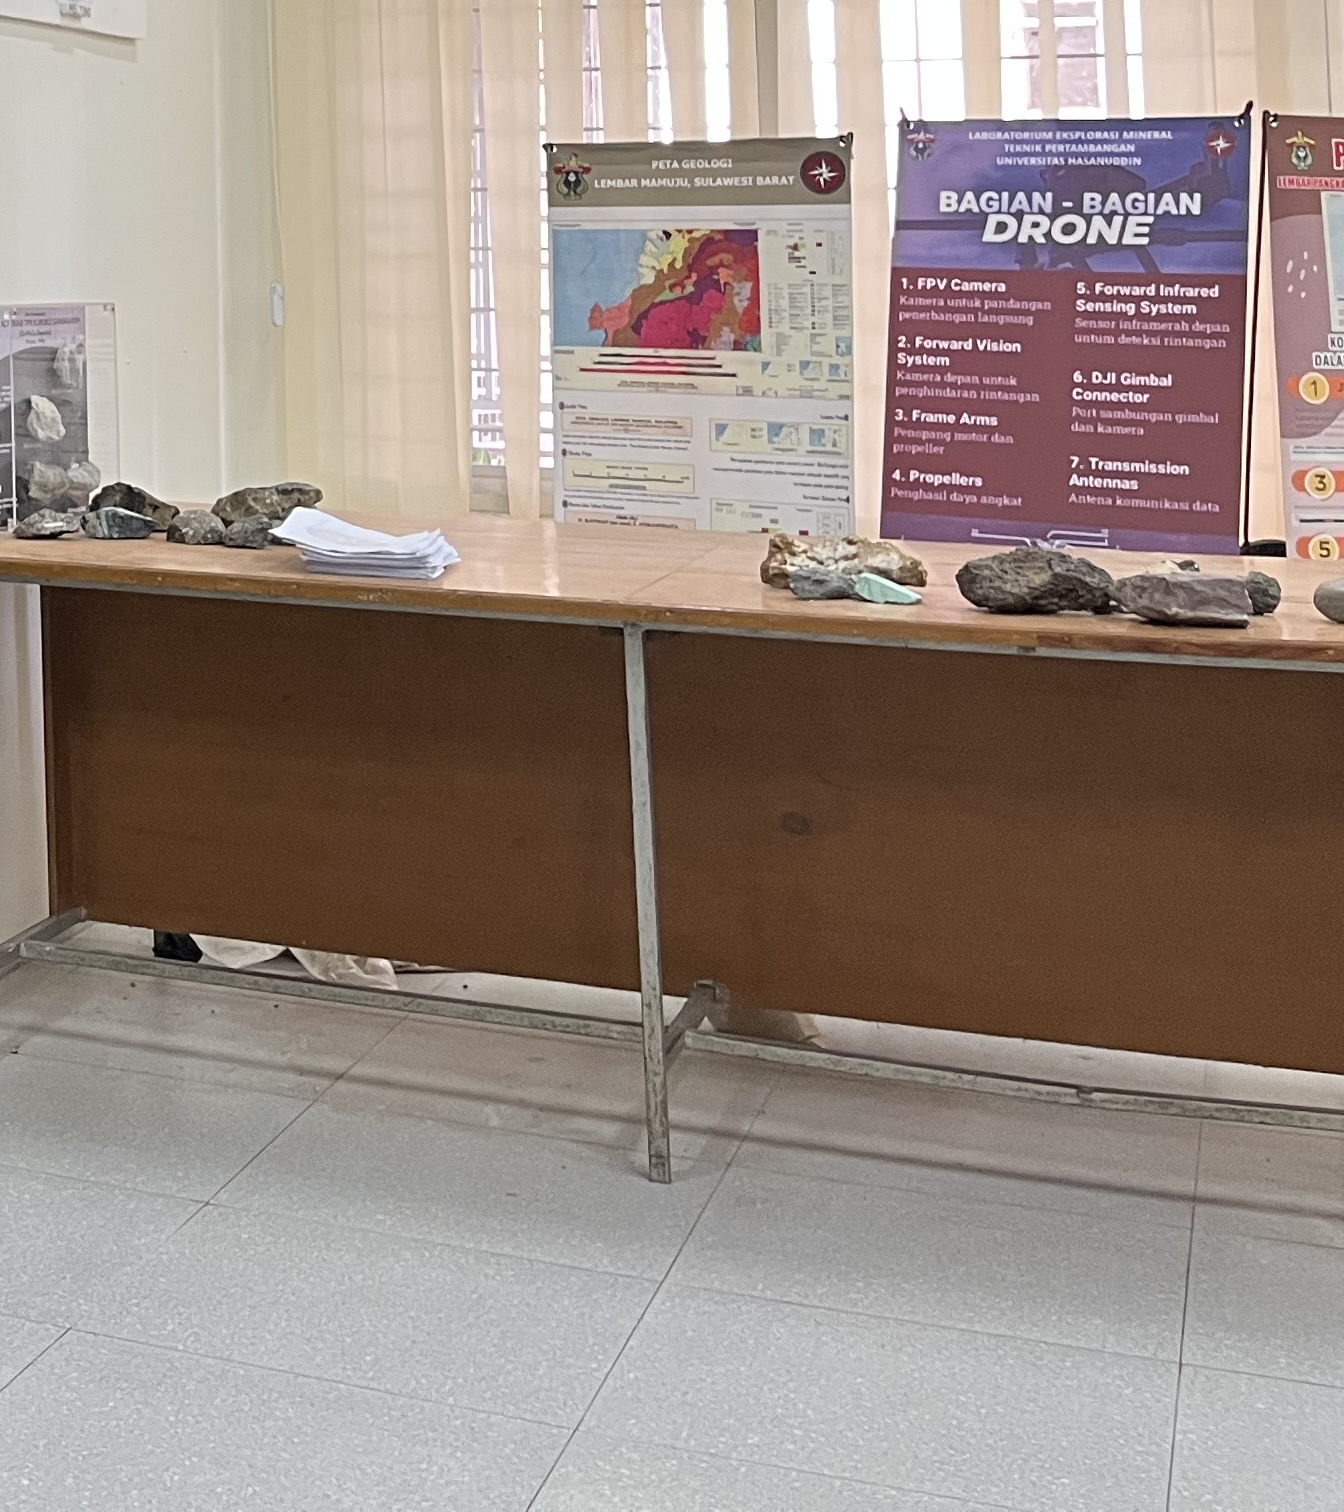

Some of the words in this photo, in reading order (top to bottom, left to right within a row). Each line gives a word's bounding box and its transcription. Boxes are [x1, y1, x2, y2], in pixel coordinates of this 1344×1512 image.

[968, 130, 1053, 141] LABORATORIUM
[1055, 130, 1119, 141] EKSPLORASI
[1122, 130, 1173, 140] MINERAL
[1004, 143, 1043, 153] TEKNIK
[1045, 143, 1136, 153] PERTAMBANGAN
[651, 159, 680, 170] PETA
[681, 158, 733, 169] GEOLOGI
[996, 156, 1065, 166] UNIVERSITAS
[1067, 156, 1142, 167] HASANUDDIN
[594, 178, 639, 189] LEMBAR
[640, 176, 691, 189] MAMUJU,
[693, 176, 754, 187] SULAWESI
[756, 175, 795, 186] BARAT
[938, 190, 1054, 213] BAGIAN
[1082, 191, 1202, 215] BAGIAN
[981, 213, 1155, 246] DRONE
[901, 277, 914, 290] 1.
[917, 277, 948, 291] FPV
[950, 279, 1006, 293] Camera
[1076, 281, 1091, 295] 5.
[1094, 282, 1156, 297] Forward
[1159, 284, 1219, 298] Infrared
[899, 295, 944, 307] Kamera
[947, 296, 982, 308] untuk
[984, 298, 1052, 311] pandangan
[1075, 299, 1136, 316] Sensing
[1139, 300, 1197, 316] System
[898, 310, 975, 325] penerbangan
[1074, 317, 1116, 329] Sensor
[1119, 318, 1189, 332] inframerah
[1191, 320, 1231, 334] depan
[897, 335, 911, 349] 2.
[915, 336, 973, 351] Forward
[976, 338, 1022, 353] Vision
[1117, 334, 1161, 346] deteksi
[1163, 336, 1227, 350] rintangan
[897, 352, 950, 367] System
[896, 370, 941, 382] Kamera
[943, 372, 980, 385] depan
[982, 375, 1018, 386] untuk
[1072, 370, 1087, 384] 6.
[1091, 371, 1116, 385] DJI
[1120, 372, 1173, 387] Gimbal
[895, 385, 977, 400] penghindaran
[980, 388, 1040, 404] rintangan
[1072, 387, 1150, 403] Connector
[1310, 379, 1318, 398] 1
[894, 408, 909, 422] 3.
[912, 409, 956, 424] Frame
[959, 412, 999, 426] Arms
[1070, 421, 1094, 433] dan
[1097, 422, 1145, 436] kamera
[953, 431, 988, 442] motor
[990, 432, 1014, 444] dan
[892, 442, 945, 455] propeller
[1069, 455, 1084, 470] 7.
[1088, 457, 1190, 475] Transmission
[891, 468, 906, 482] 4.
[909, 469, 983, 487] Propellers
[1068, 473, 1139, 490] Antennas
[1314, 474, 1327, 492] 3
[949, 490, 978, 504] daya
[980, 494, 1023, 507] angkat
[1068, 492, 1112, 505] Antena
[1115, 494, 1190, 511] komunikasi
[1192, 500, 1220, 513] data
[1318, 541, 1332, 559] 5
